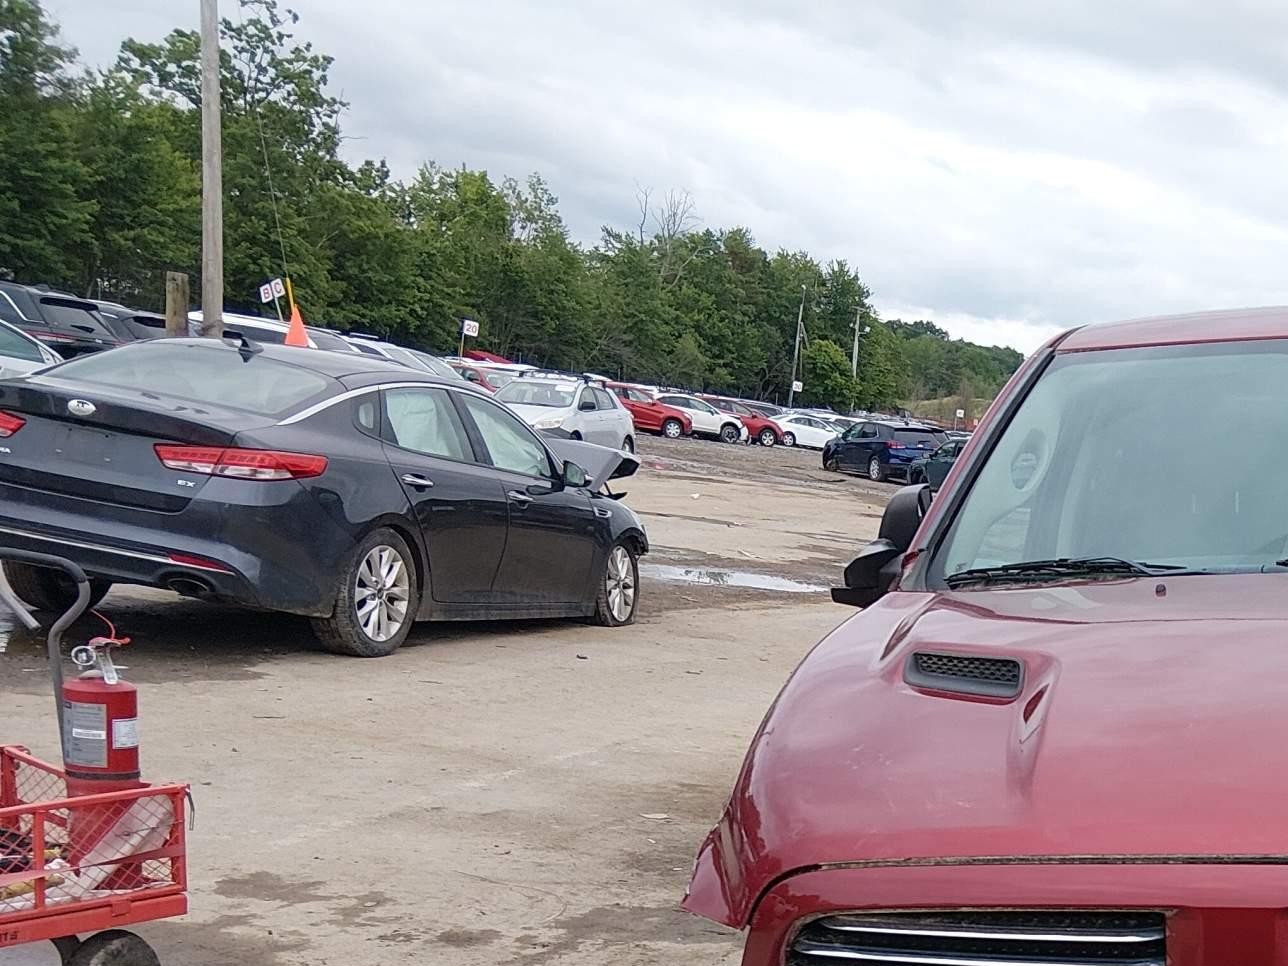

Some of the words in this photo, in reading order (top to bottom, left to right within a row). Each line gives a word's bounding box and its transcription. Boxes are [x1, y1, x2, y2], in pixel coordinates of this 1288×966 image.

[263, 287, 271, 300] B
[274, 282, 282, 294] C
[466, 323, 477, 334] 20
